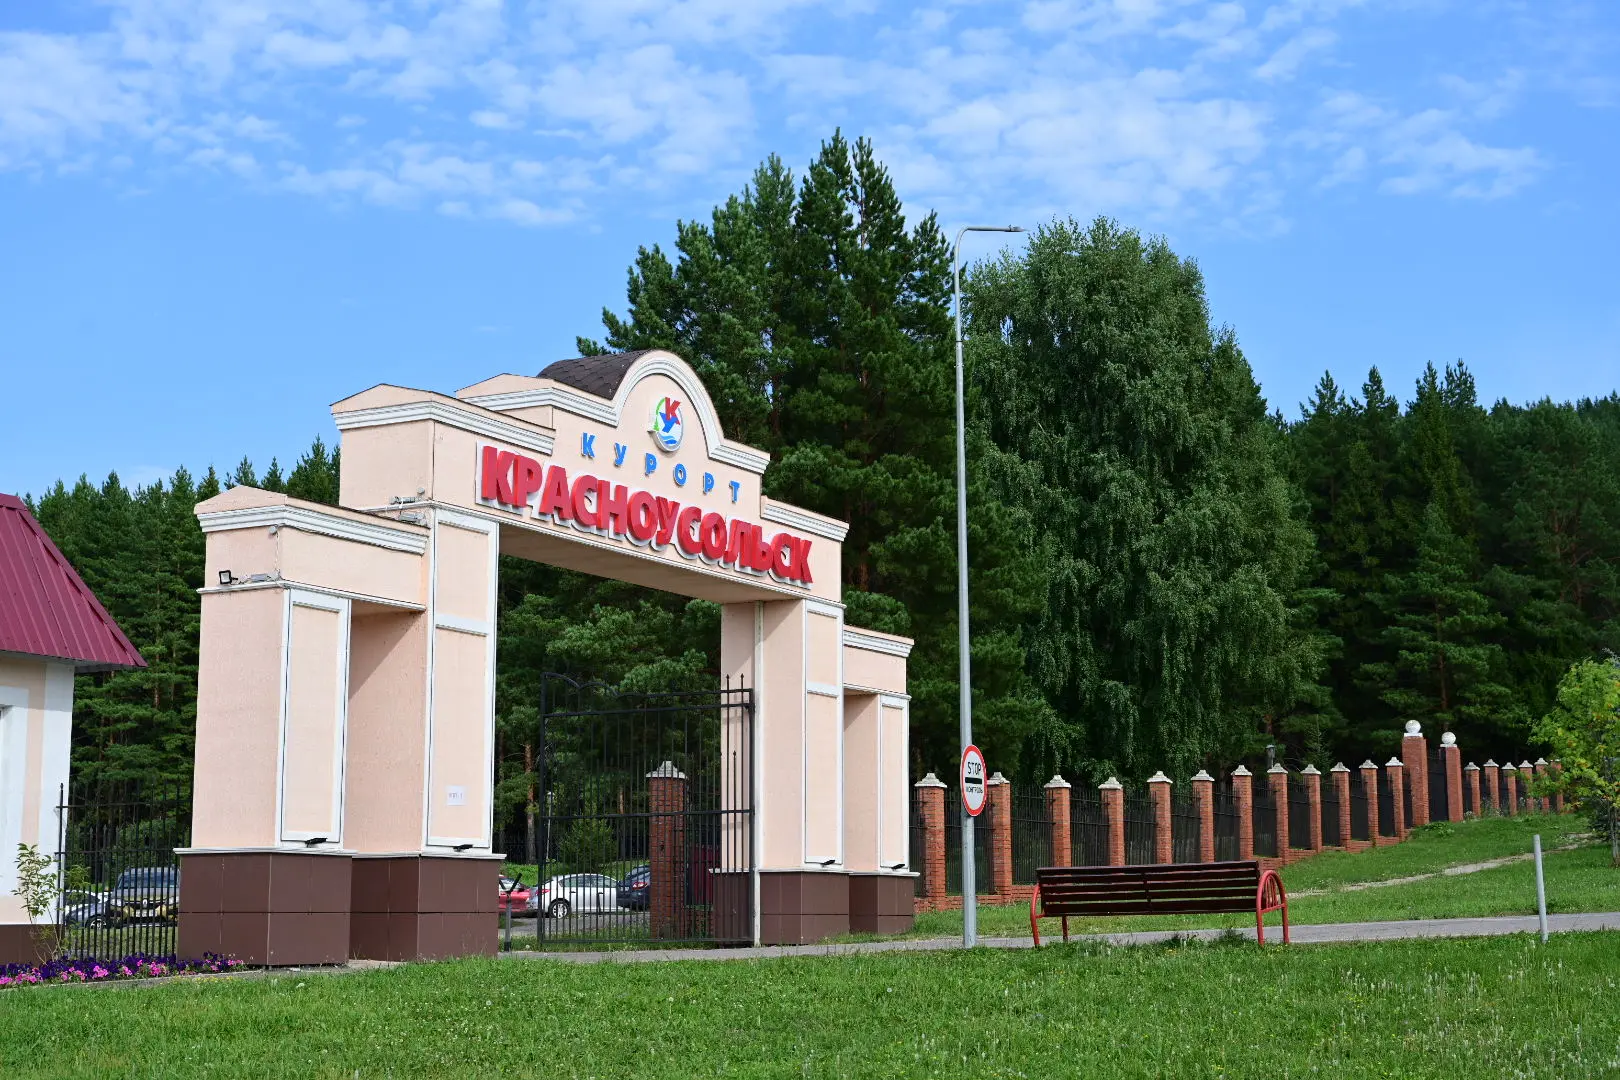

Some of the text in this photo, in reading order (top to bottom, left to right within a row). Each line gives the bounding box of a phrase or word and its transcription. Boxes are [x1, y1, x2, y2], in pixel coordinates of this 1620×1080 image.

[581, 432, 740, 502] КУРОРТ
[481, 446, 813, 584] КРАСНОУСОЛЬСК
[967, 762, 981, 775] STOP
